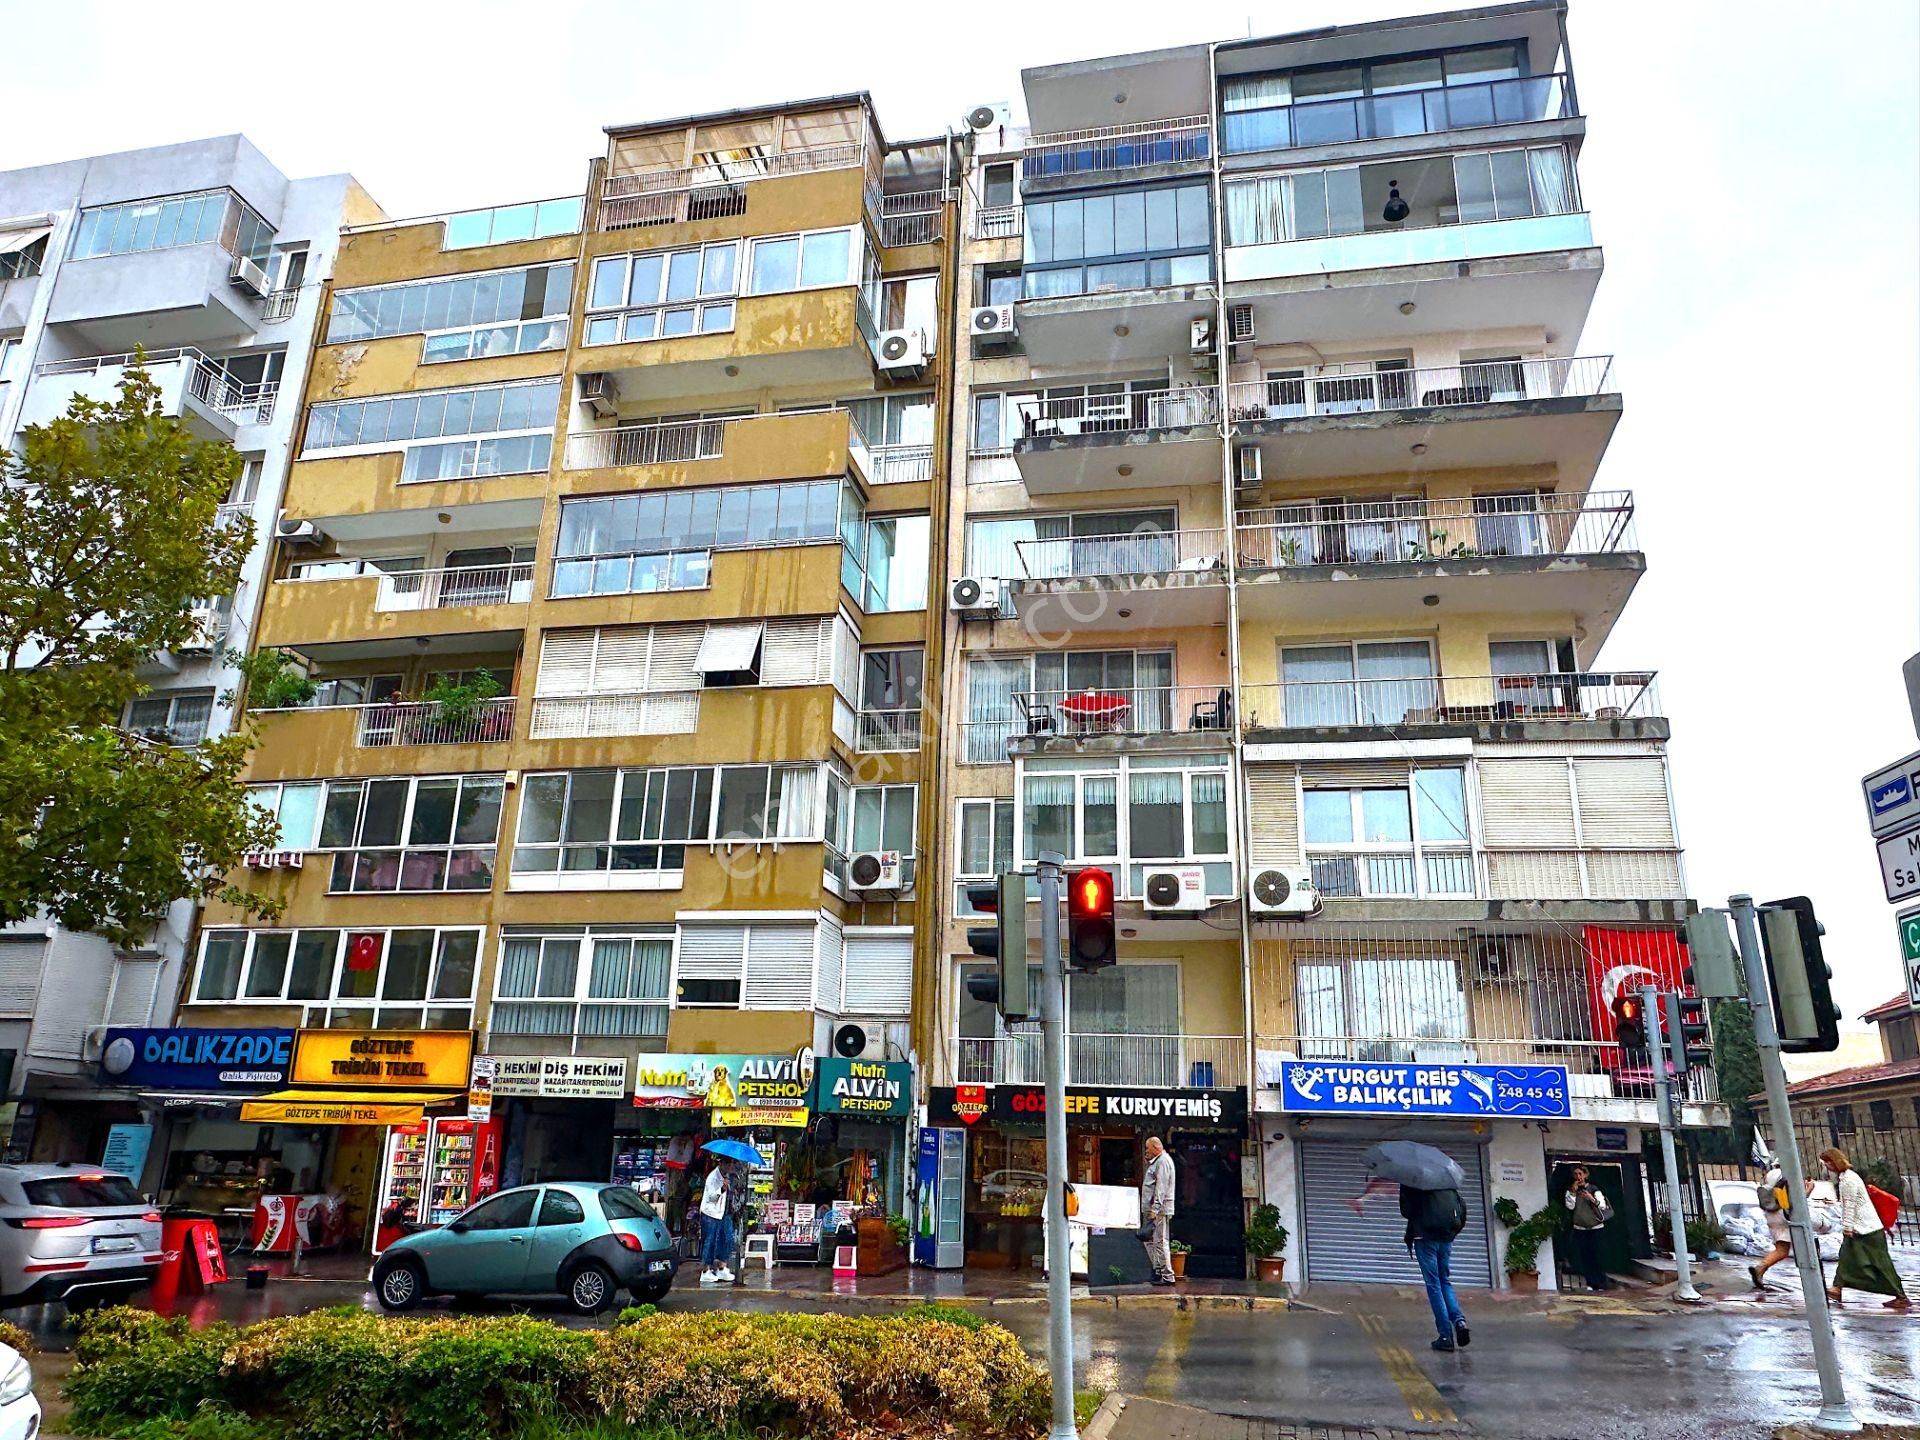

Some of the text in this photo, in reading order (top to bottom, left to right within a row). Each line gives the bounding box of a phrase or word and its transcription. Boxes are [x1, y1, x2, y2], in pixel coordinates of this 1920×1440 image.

[350, 1036, 414, 1054] GÖZTEPE
[385, 1061, 428, 1077] TEKEL
[545, 1062, 623, 1077] DİŞ HEKİMİ
[850, 1062, 886, 1078] Nutri
[1324, 1066, 1461, 1087] TURGUT REİS
[640, 1069, 687, 1087] Nutri
[1333, 1086, 1453, 1110] BALIKÇILIK
[1498, 1087, 1563, 1098] 248 45 45
[841, 1098, 892, 1111] PETSHOP
[952, 1102, 989, 1113] GÖZTEPE
[1106, 1093, 1221, 1122] KURUYEMİŞ
[285, 1108, 321, 1118] GÖZTEPE
[353, 1110, 379, 1120] TEKEL
